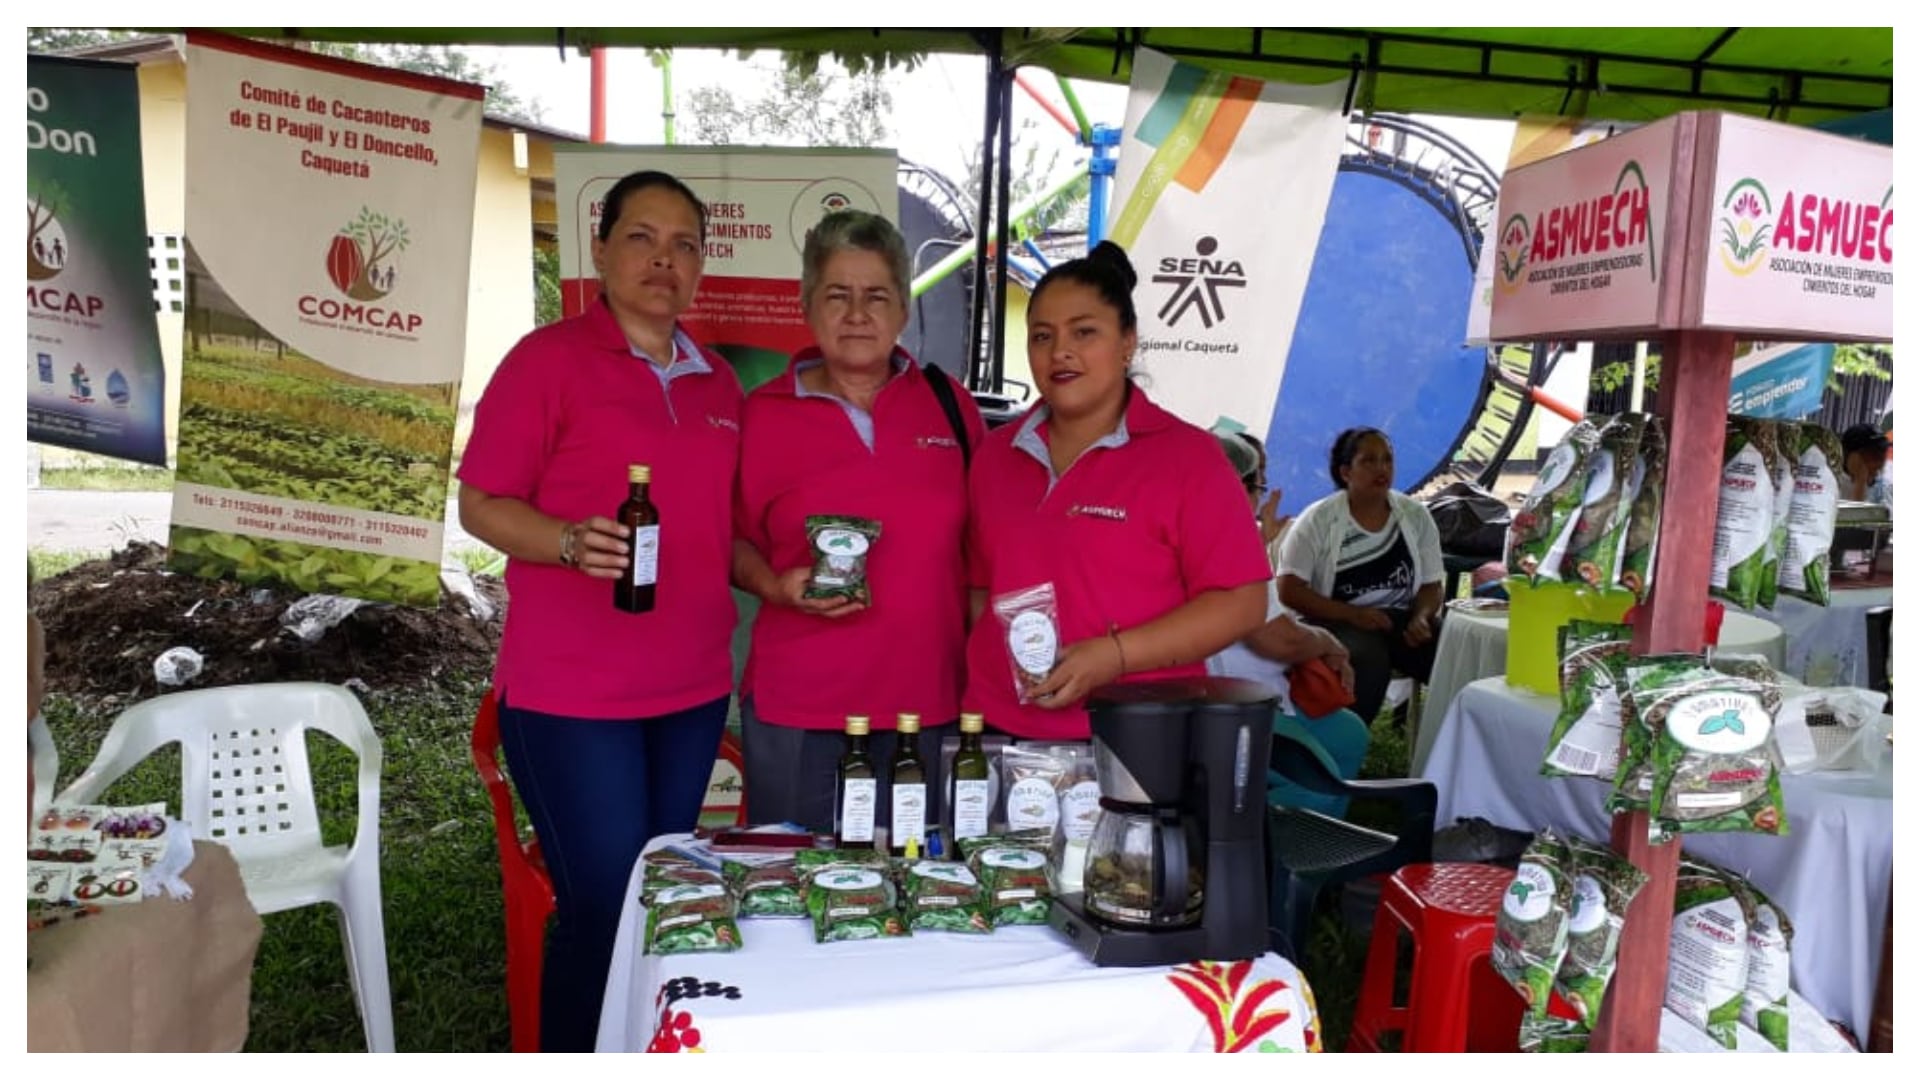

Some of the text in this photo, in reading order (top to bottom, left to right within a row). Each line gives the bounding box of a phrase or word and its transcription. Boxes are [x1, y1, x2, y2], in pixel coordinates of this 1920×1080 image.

[240, 80, 431, 135] Comité de Cacaoteros
[230, 109, 439, 167] de El Paujil y El Doncello,
[301, 149, 371, 179] Caquetá
[1530, 186, 1649, 263] ASMUECH
[1773, 190, 1893, 264] ASMUEC
[1159, 257, 1246, 277] SENA
[1813, 262, 1823, 276] DE
[1853, 285, 1877, 299] HOGAR
[298, 295, 423, 333] COMCAP
[1184, 339, 1239, 354] Caquetá
